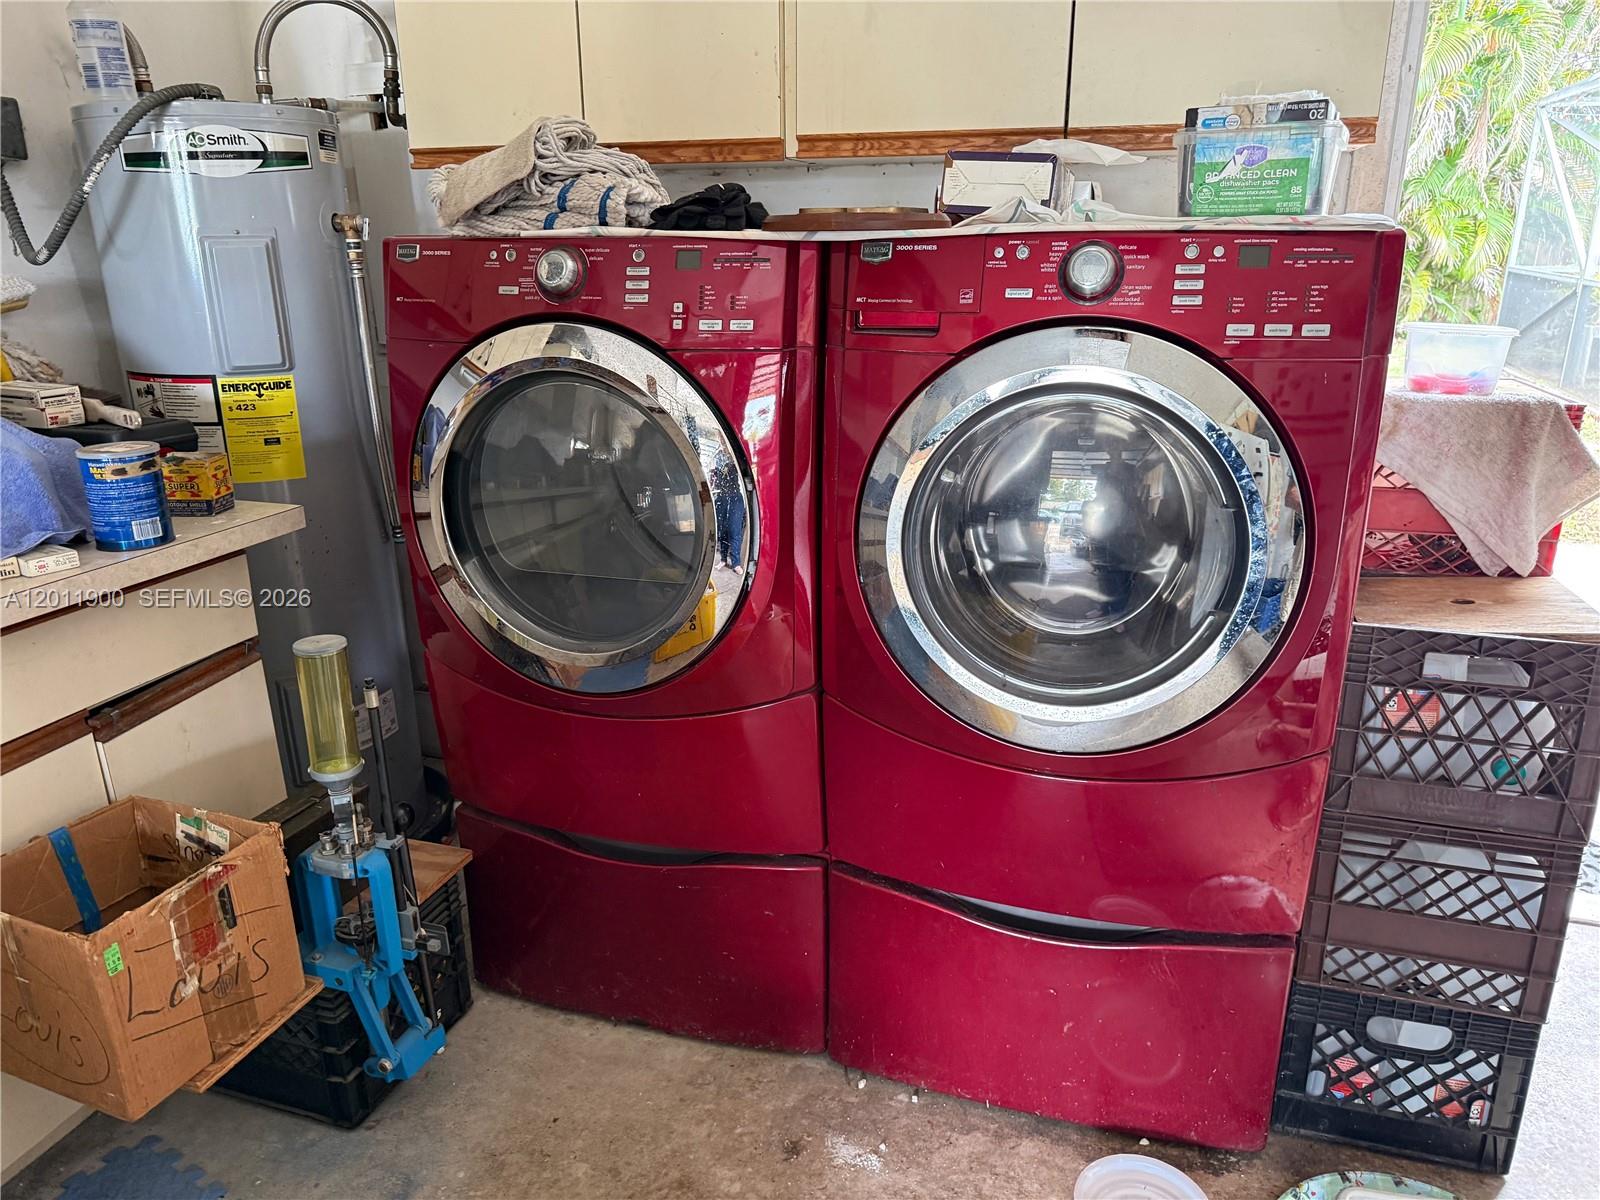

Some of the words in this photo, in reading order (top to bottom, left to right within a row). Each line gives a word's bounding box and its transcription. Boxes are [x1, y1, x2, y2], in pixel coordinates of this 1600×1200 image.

[1309, 109, 1325, 120] 20
[1205, 170, 1261, 181] ADANCED
[1263, 168, 1298, 178] CLEAN
[1290, 185, 1302, 194] 85
[864, 246, 889, 254] MAYTAG
[221, 380, 293, 396] ENERGYGUIDE
[235, 403, 257, 411] 423
[167, 482, 196, 491] SUPER
